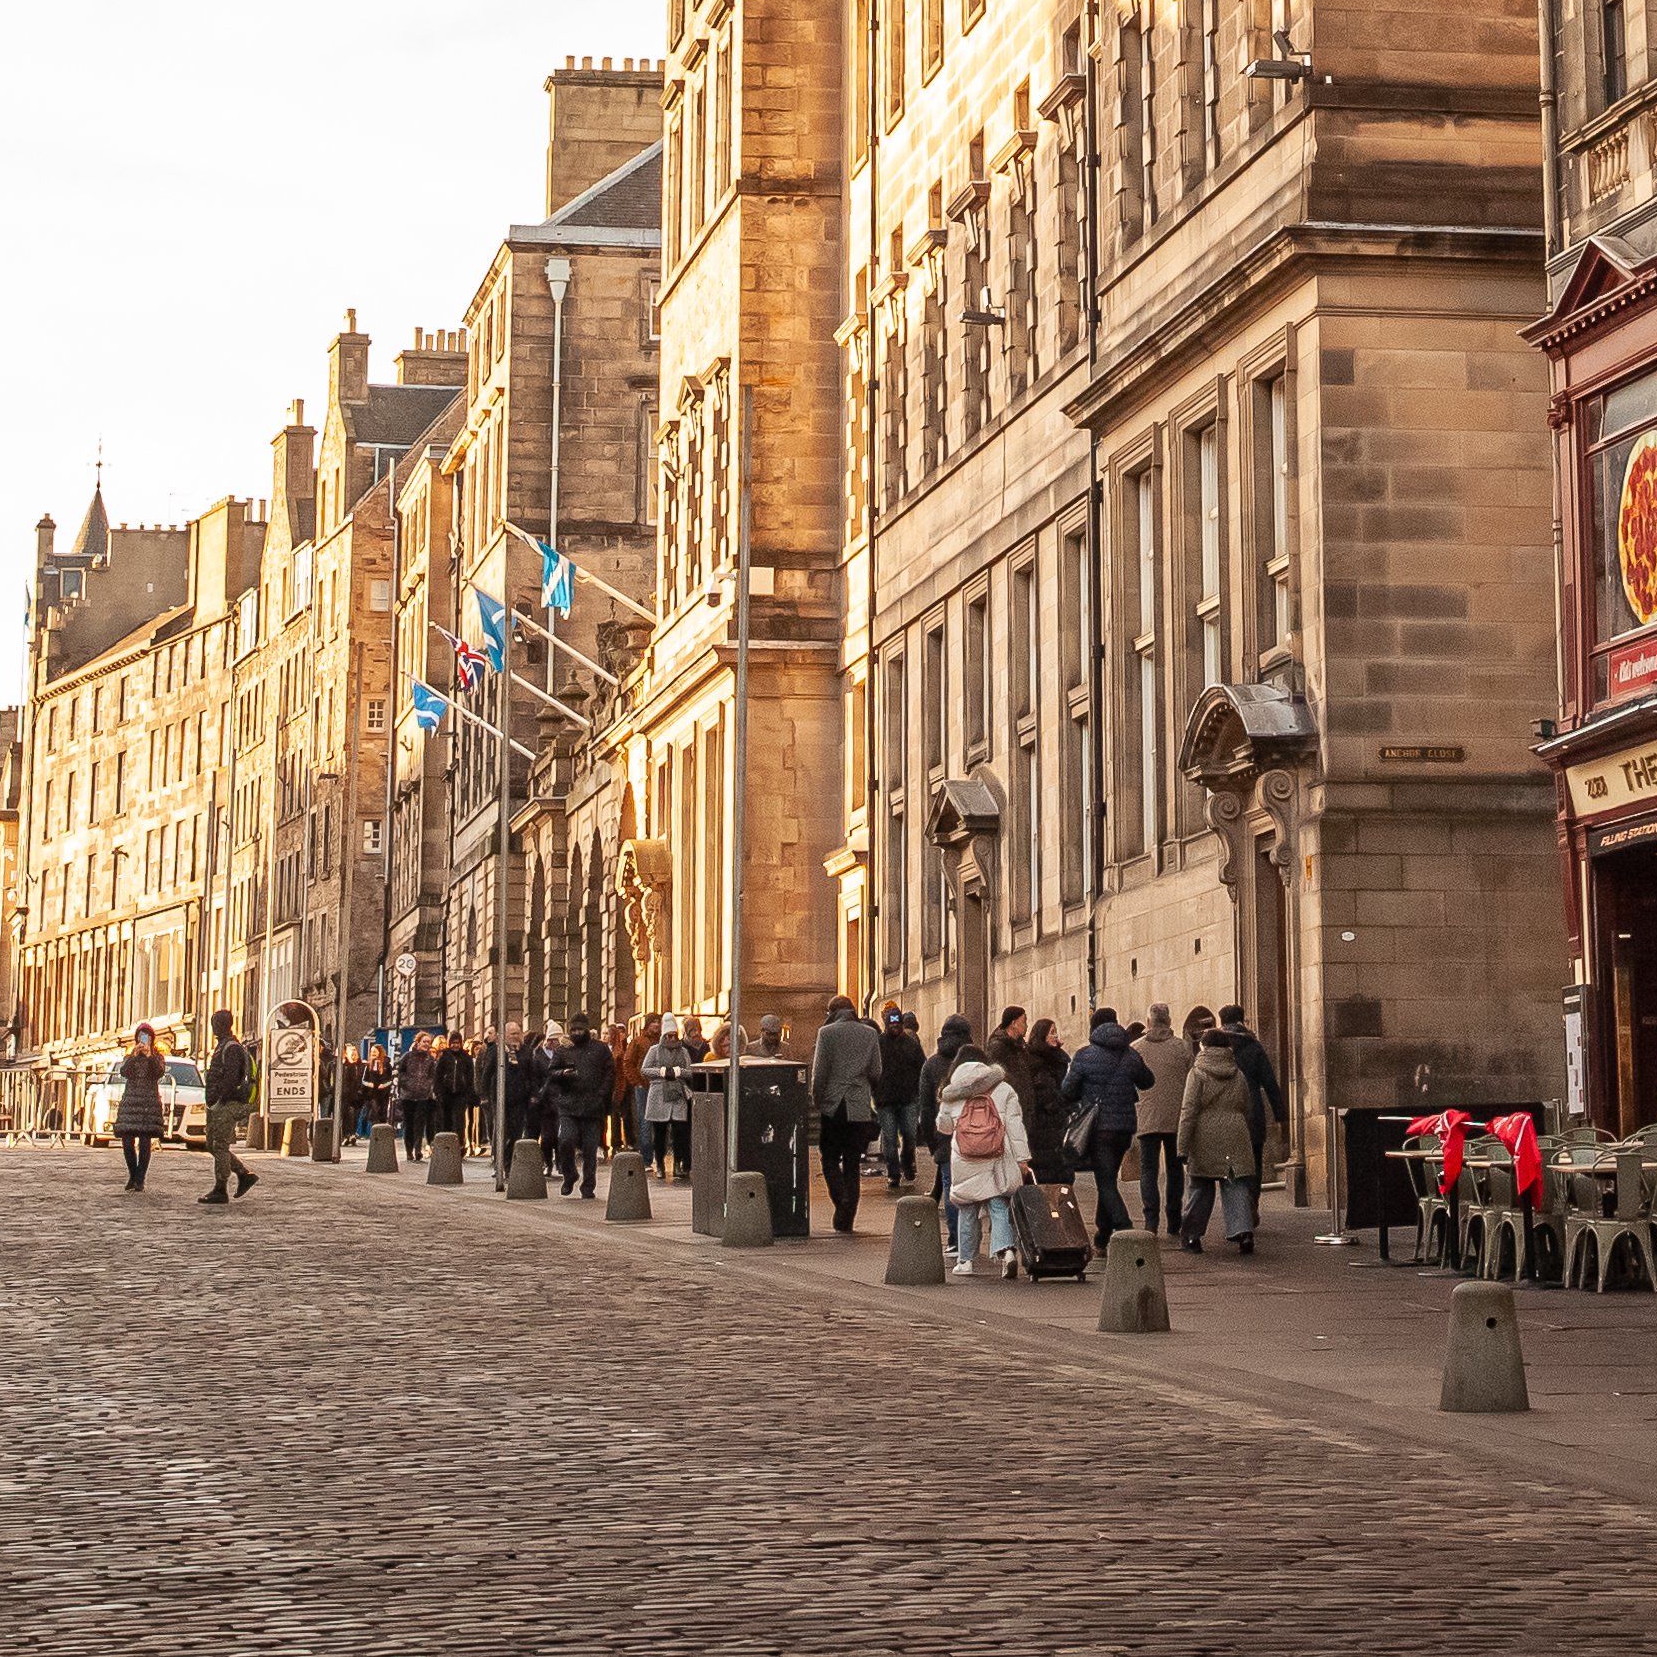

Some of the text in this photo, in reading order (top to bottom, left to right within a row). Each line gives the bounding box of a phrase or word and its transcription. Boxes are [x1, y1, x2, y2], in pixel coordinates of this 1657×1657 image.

[1428, 749, 1458, 758] CLOSE
[1600, 830, 1627, 847] FILLING
[277, 1086, 306, 1096] ENDS
